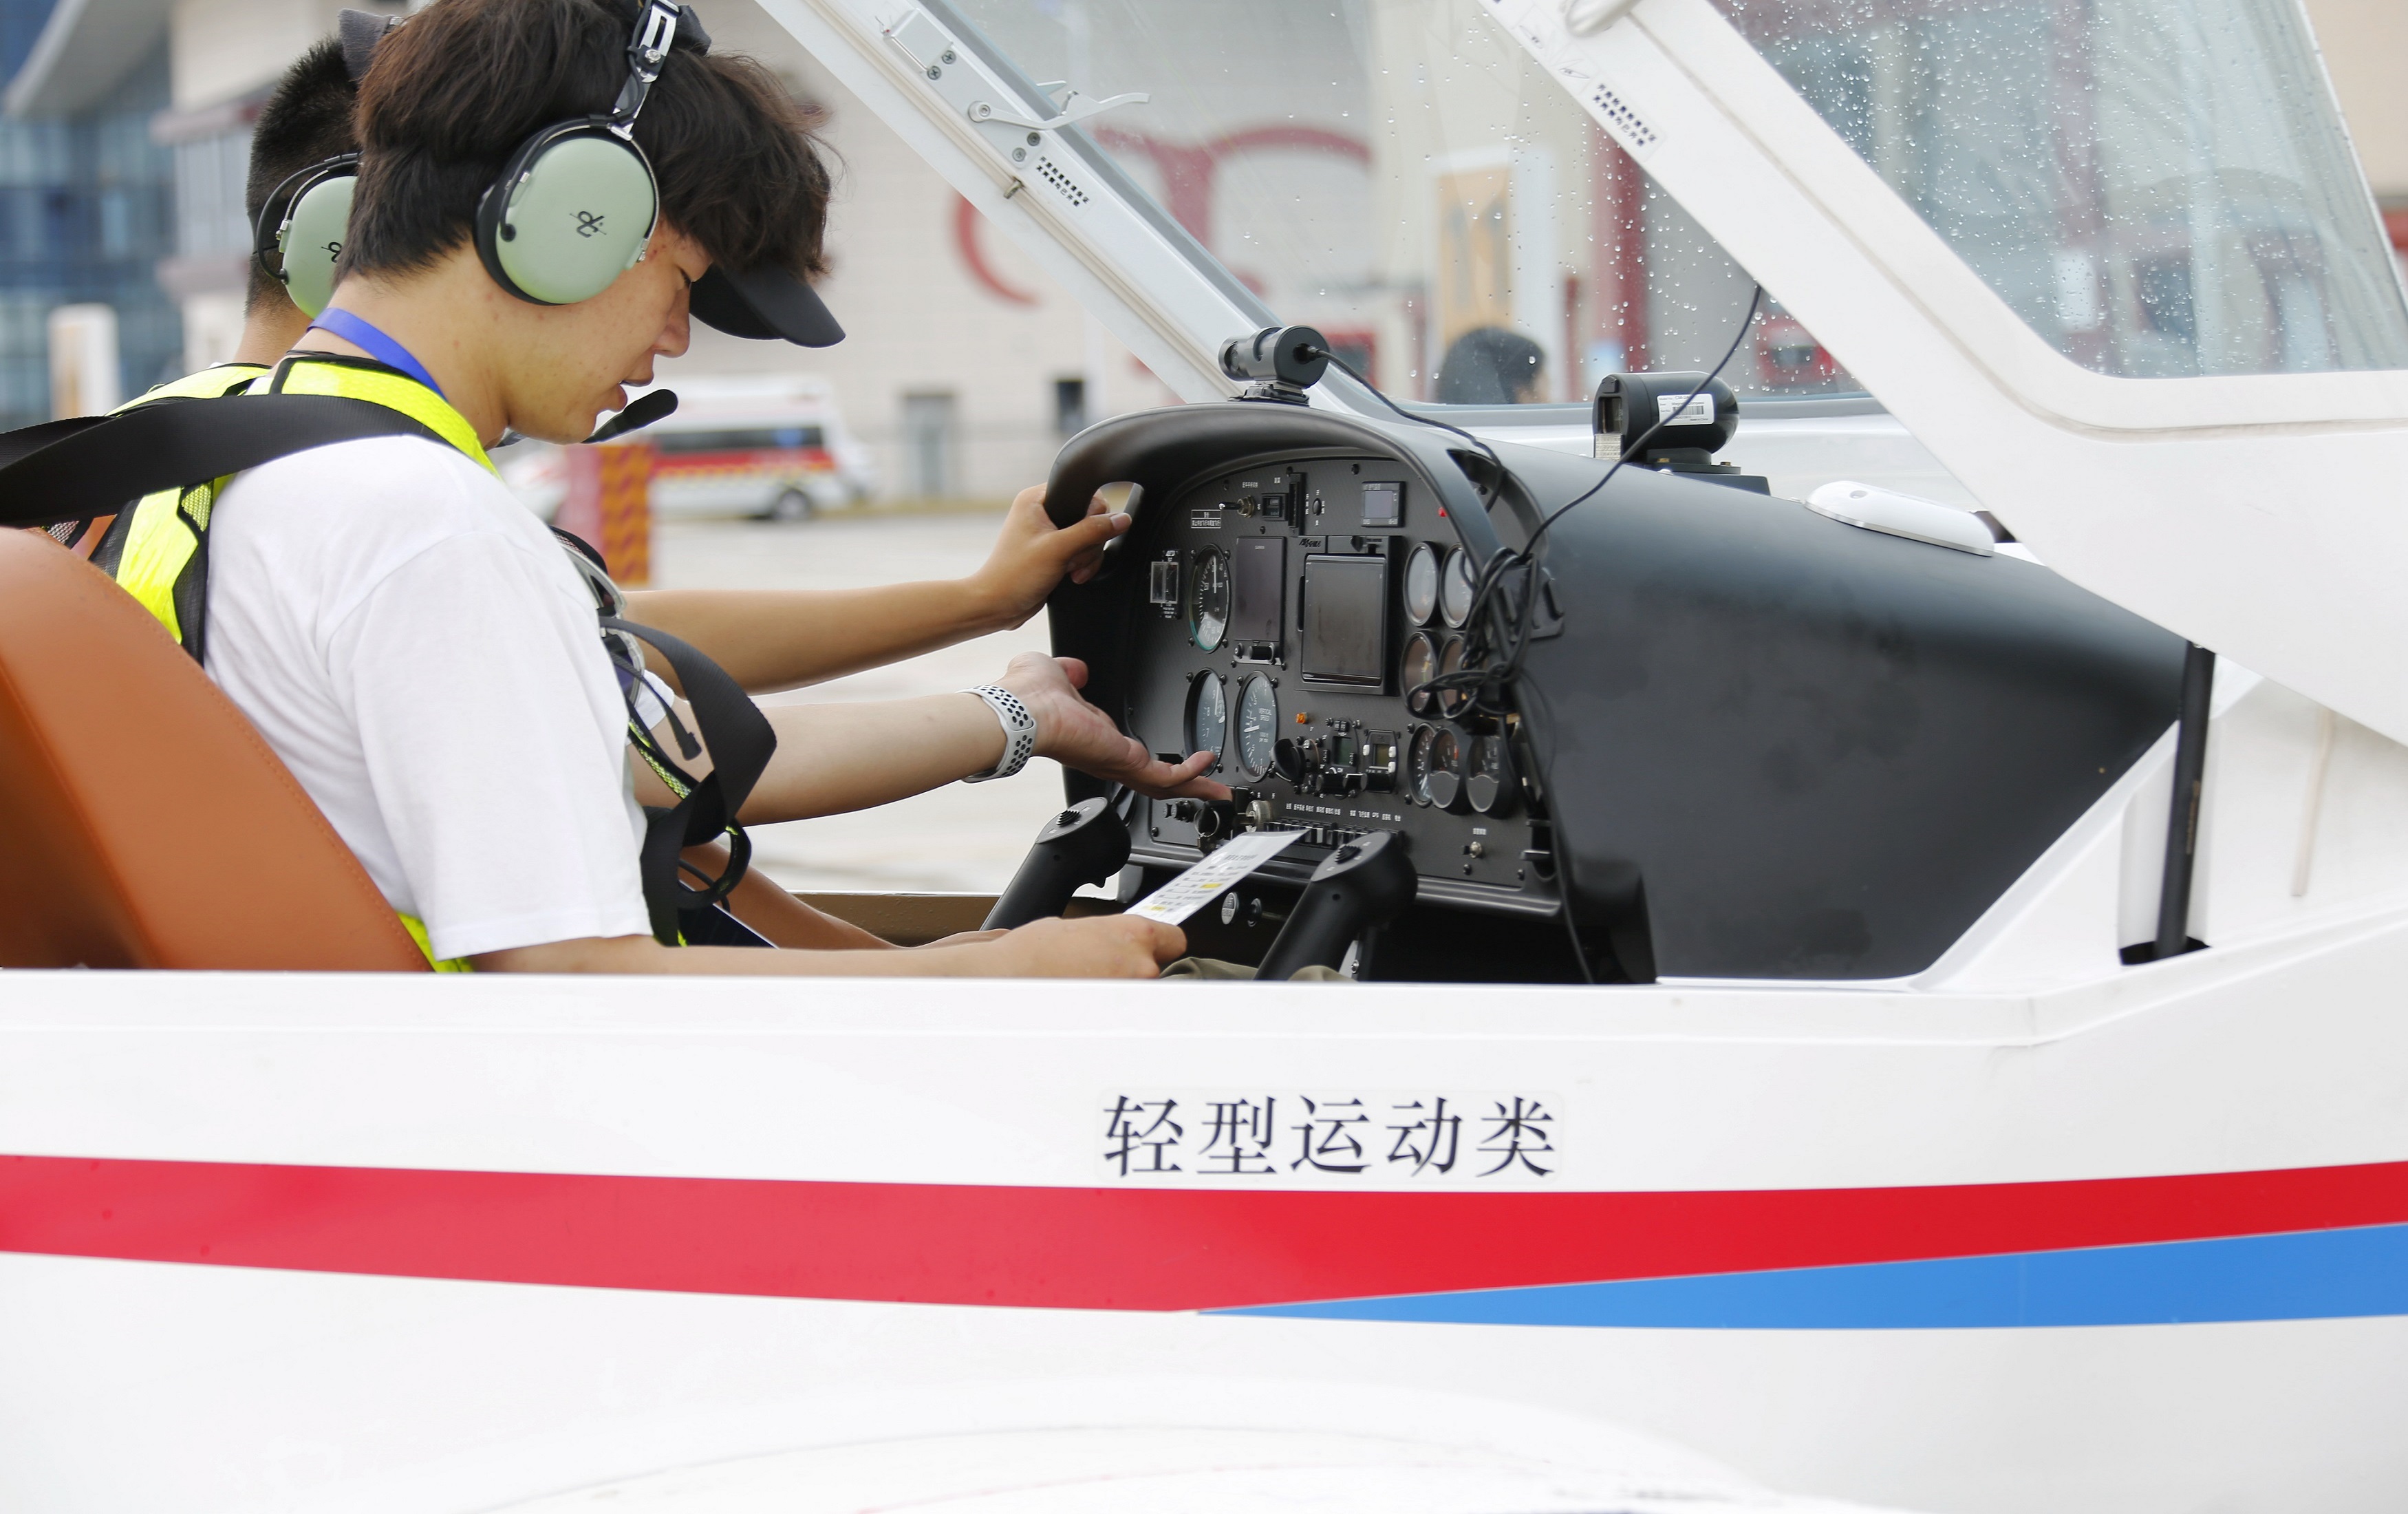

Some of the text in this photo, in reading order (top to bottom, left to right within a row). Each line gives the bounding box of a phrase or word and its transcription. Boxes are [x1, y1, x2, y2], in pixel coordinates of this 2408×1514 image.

[1102, 1095, 1556, 1177] 轻型运动类
